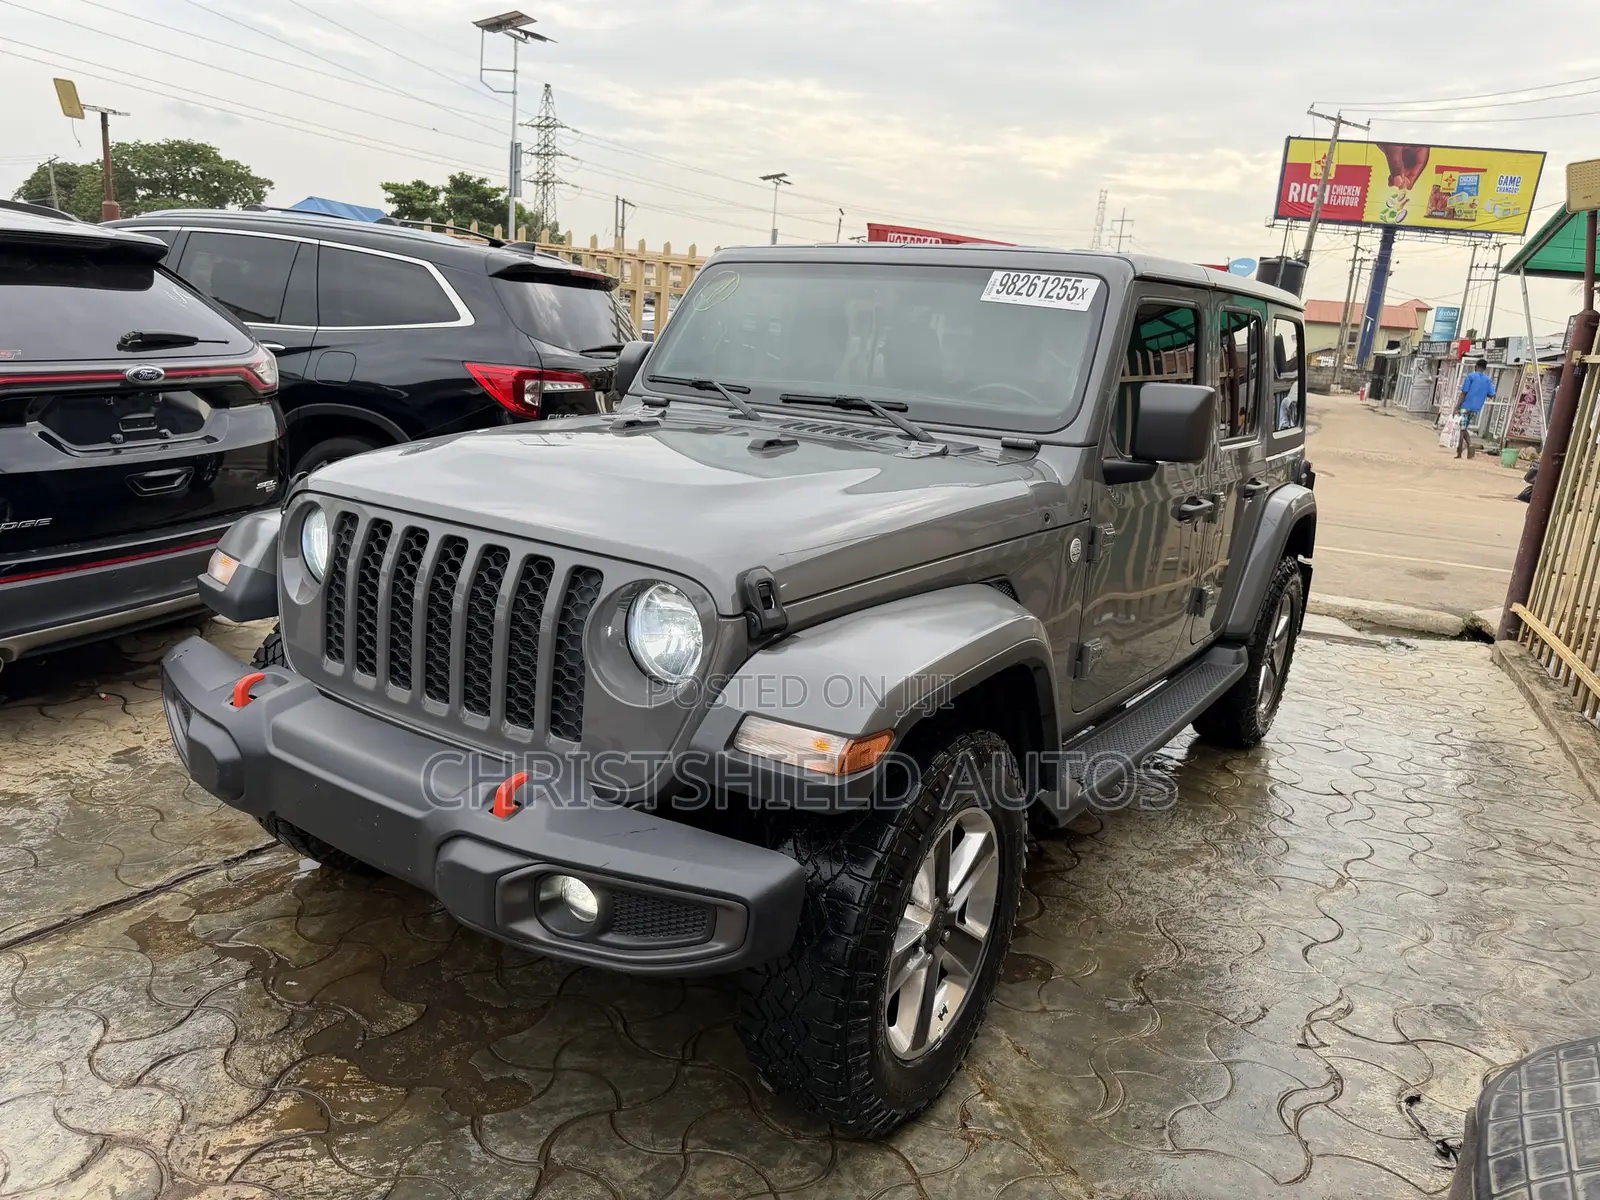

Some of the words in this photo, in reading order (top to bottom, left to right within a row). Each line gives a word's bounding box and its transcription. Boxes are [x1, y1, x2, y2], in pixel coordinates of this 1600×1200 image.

[1332, 184, 1361, 197] CHICKEN
[1330, 195, 1359, 206] FLAVOUR
[0, 517, 52, 533] DGE
